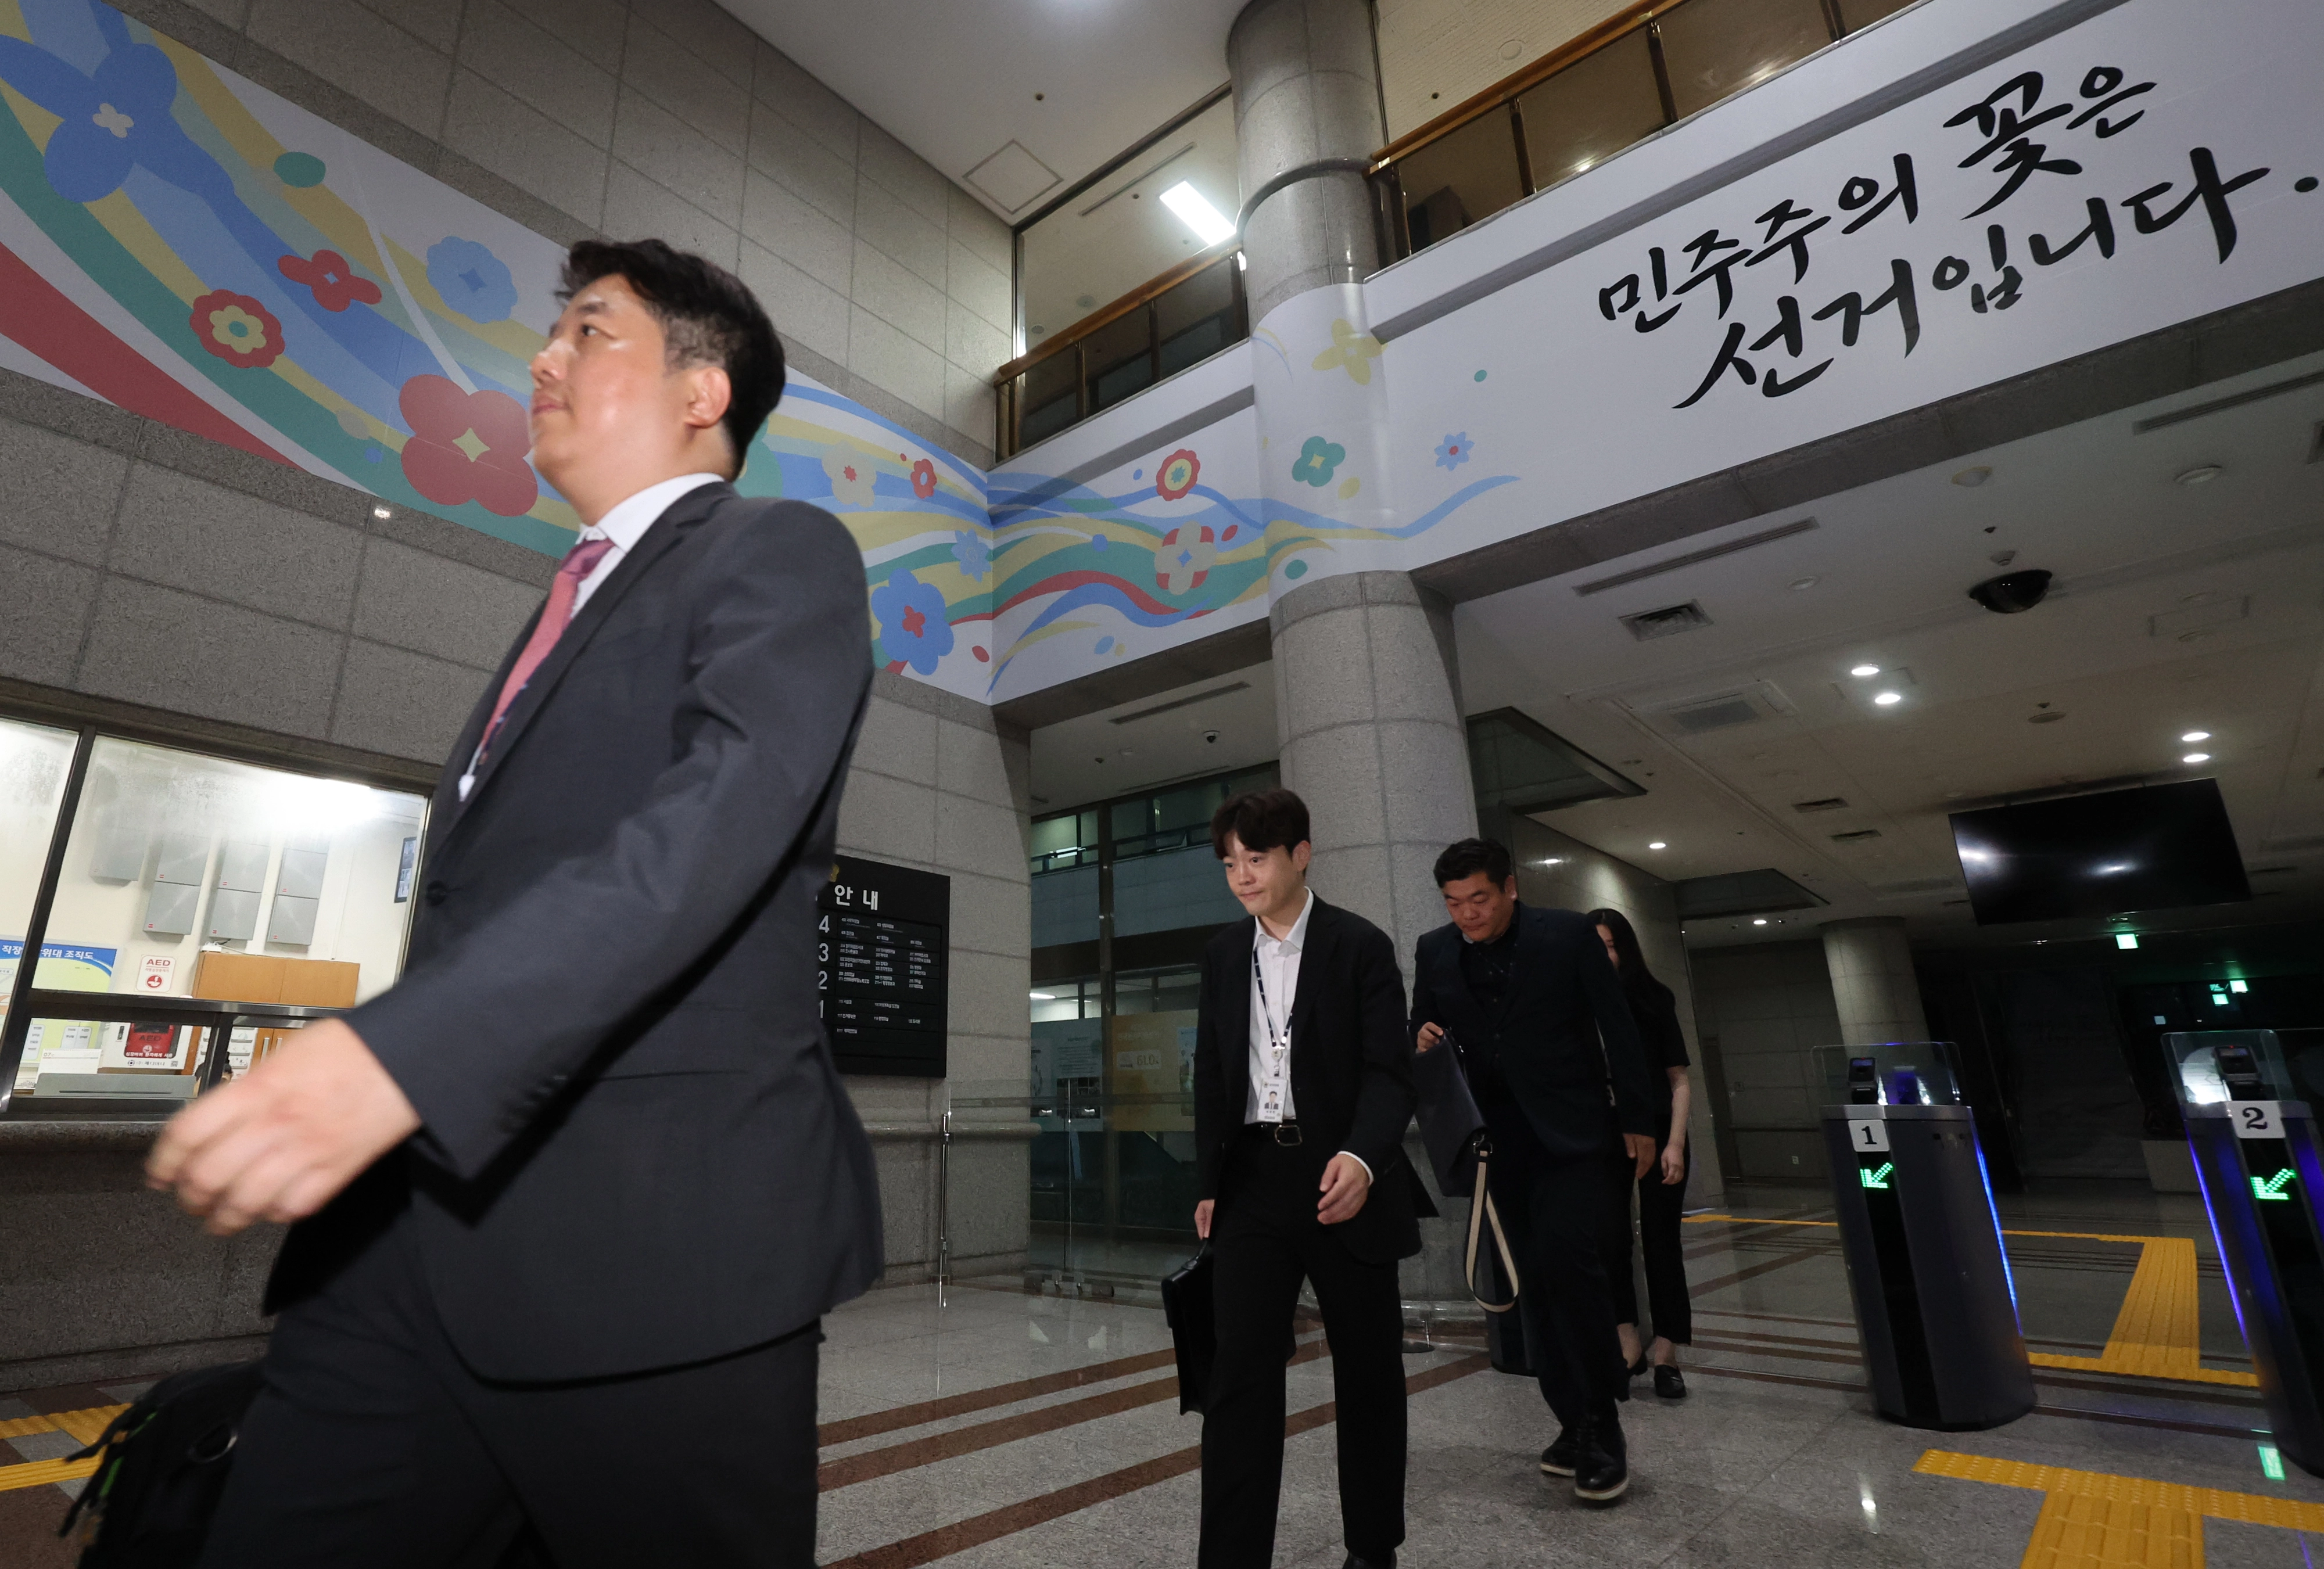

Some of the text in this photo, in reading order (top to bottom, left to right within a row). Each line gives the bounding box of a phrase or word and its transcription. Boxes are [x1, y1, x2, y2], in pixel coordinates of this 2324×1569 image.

[1598, 66, 2158, 333] 민주주의 꽃은
[1672, 147, 2319, 410] 선거입니다.
[818, 915, 830, 933] 4
[64, 949, 94, 960] 조직도
[818, 943, 829, 962] 3
[146, 958, 171, 967] AED
[818, 971, 828, 990] 2
[819, 1000, 824, 1019] 1
[2242, 1107, 2268, 1130] 2
[1862, 1126, 1877, 1145] 1
